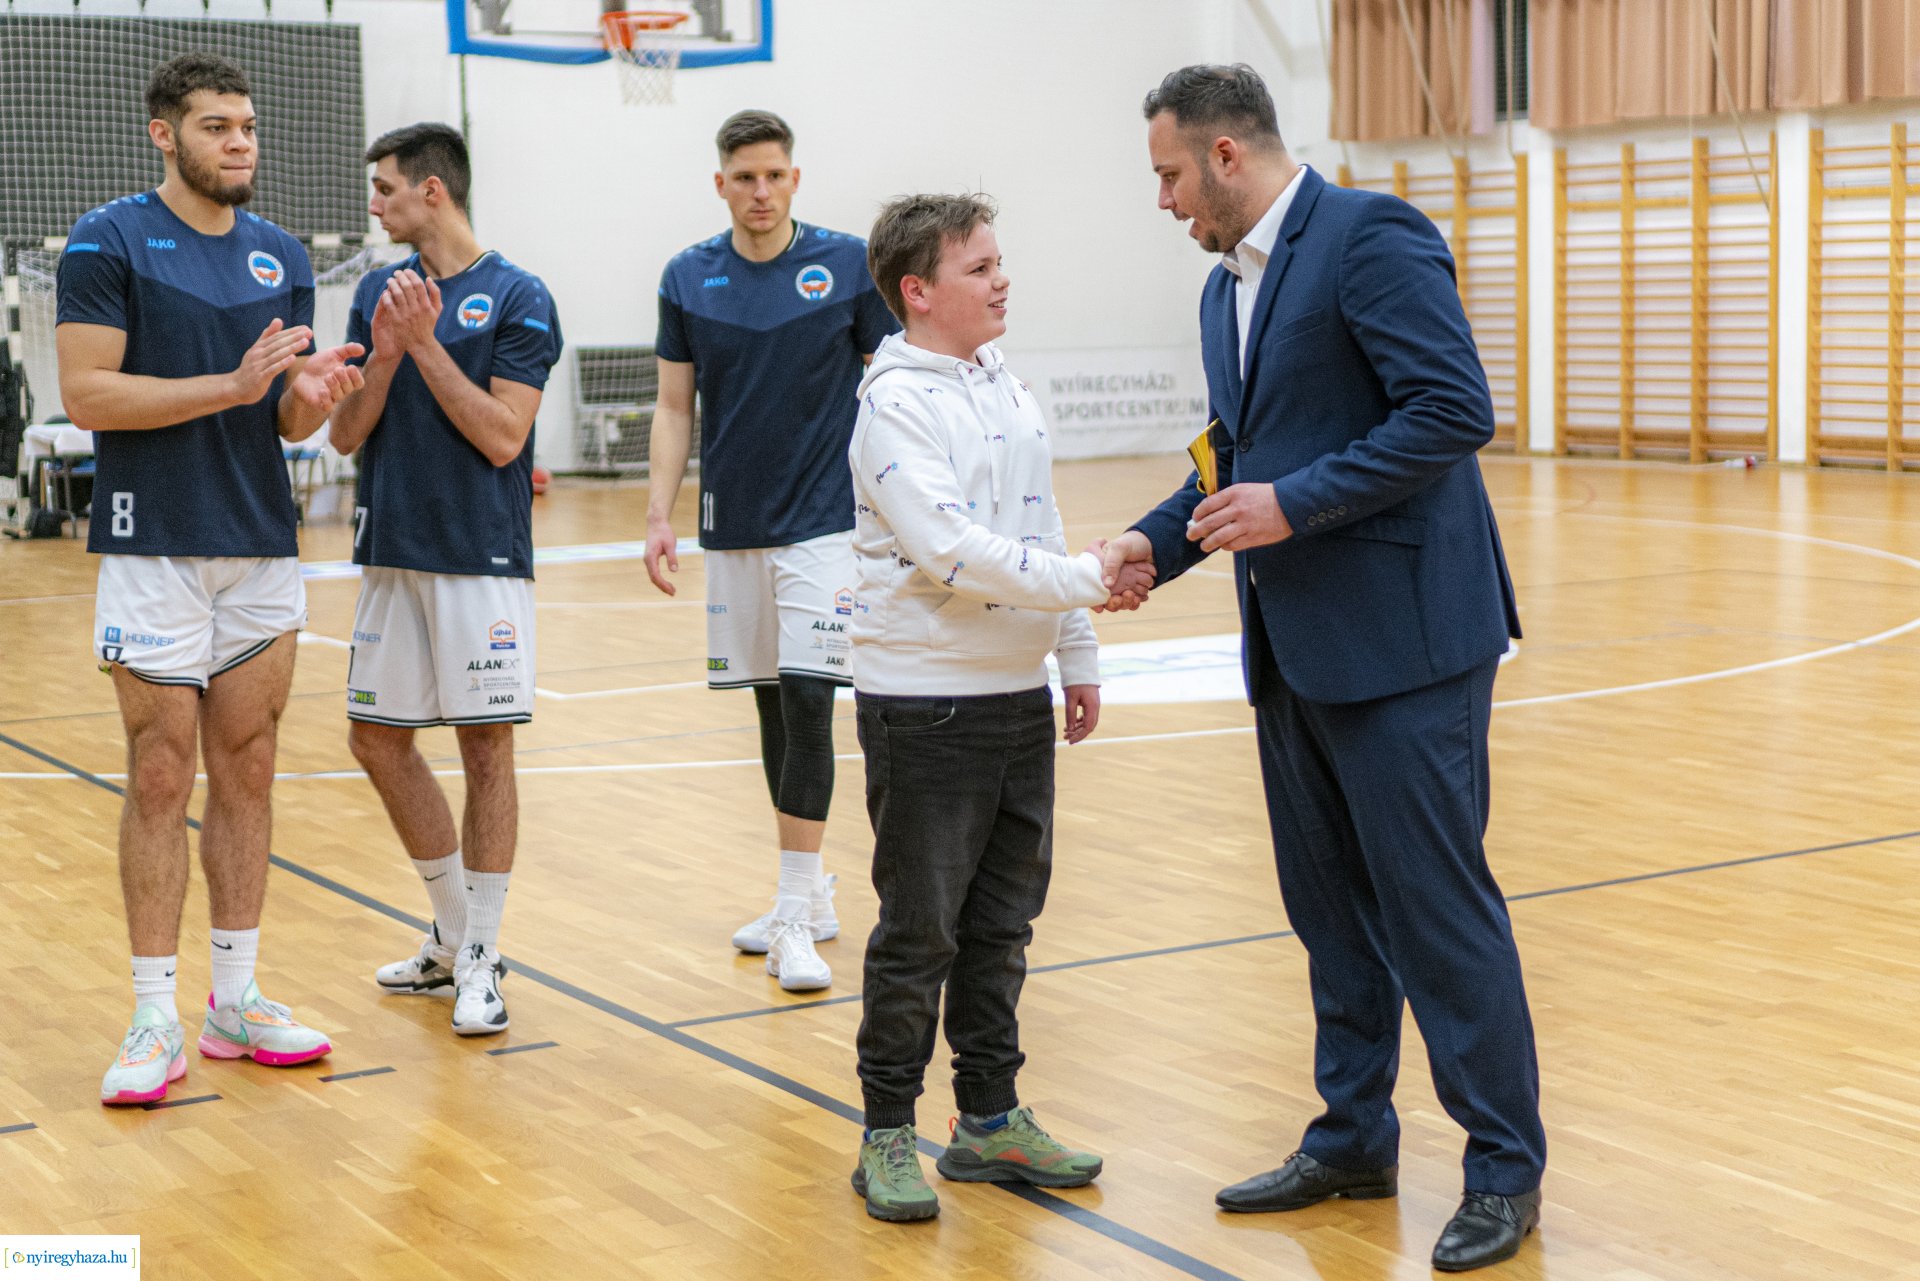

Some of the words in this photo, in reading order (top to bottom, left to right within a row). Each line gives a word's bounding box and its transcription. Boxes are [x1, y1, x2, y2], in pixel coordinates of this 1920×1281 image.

[147, 238, 176, 249] JAKO
[703, 276, 729, 288] JAKO
[111, 491, 134, 538] 8
[703, 491, 714, 532] 11
[354, 506, 368, 549] 7
[811, 620, 849, 633] ALANE
[825, 655, 845, 667] JAKO
[487, 694, 514, 705] JAKO
